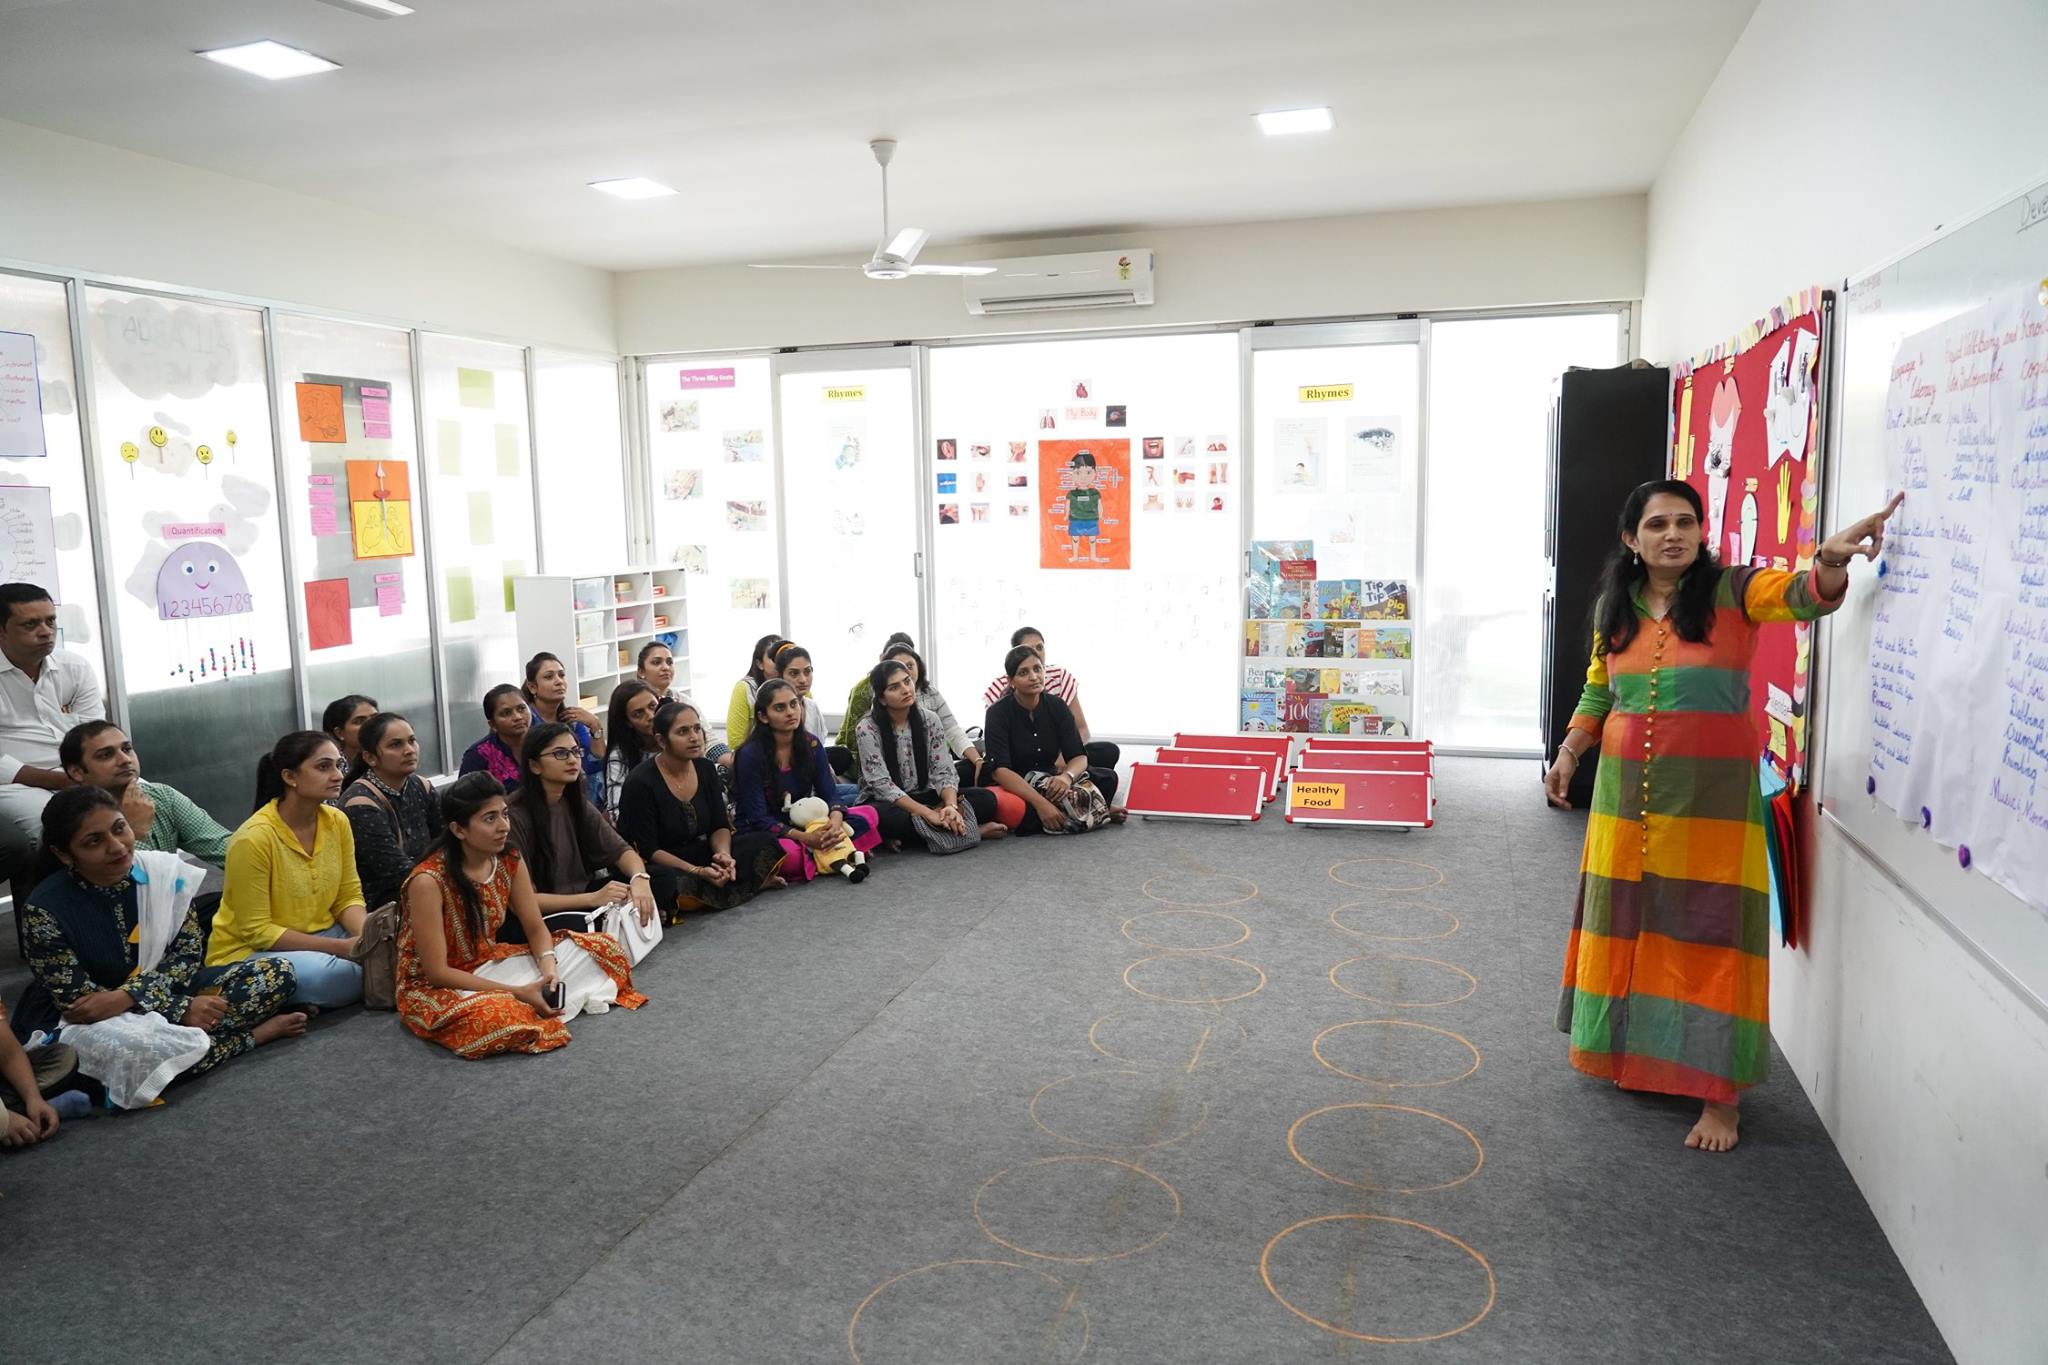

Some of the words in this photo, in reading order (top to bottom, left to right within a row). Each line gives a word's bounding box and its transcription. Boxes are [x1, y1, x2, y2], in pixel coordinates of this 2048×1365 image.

[828, 389, 863, 400] Rhymes
[1306, 388, 1349, 401] Rhymes
[171, 526, 223, 536] Quantification
[1365, 581, 1384, 592] Tip
[1366, 592, 1385, 604] Tip
[1387, 598, 1406, 614] Dig
[1297, 785, 1340, 796] Healthy
[1303, 798, 1331, 806] Food
